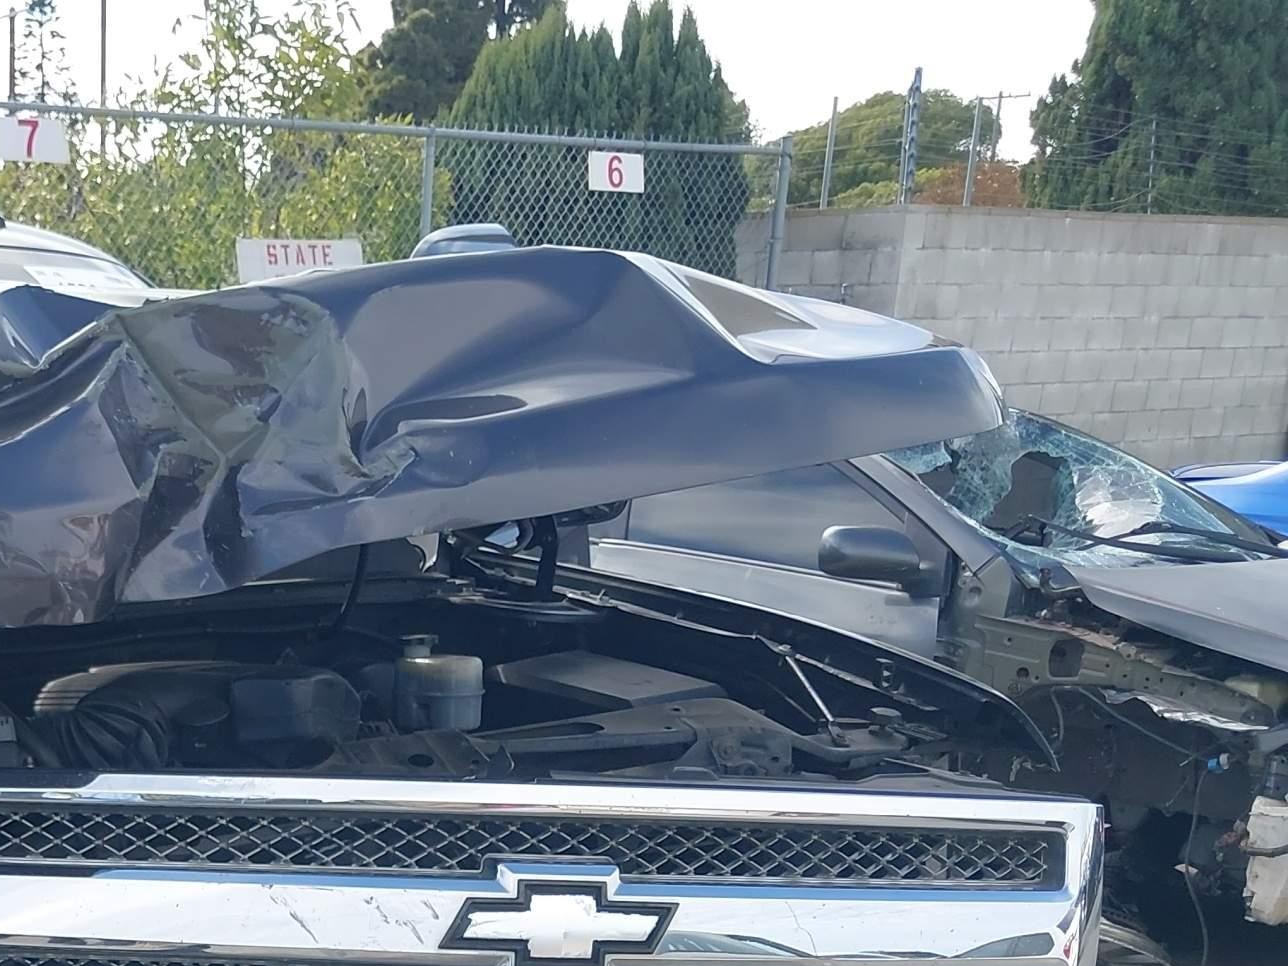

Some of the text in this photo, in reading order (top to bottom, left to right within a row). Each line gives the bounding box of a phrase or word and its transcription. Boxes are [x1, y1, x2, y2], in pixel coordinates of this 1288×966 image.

[17, 119, 39, 158] 7
[608, 155, 623, 188] 6
[266, 244, 333, 265] STATE
